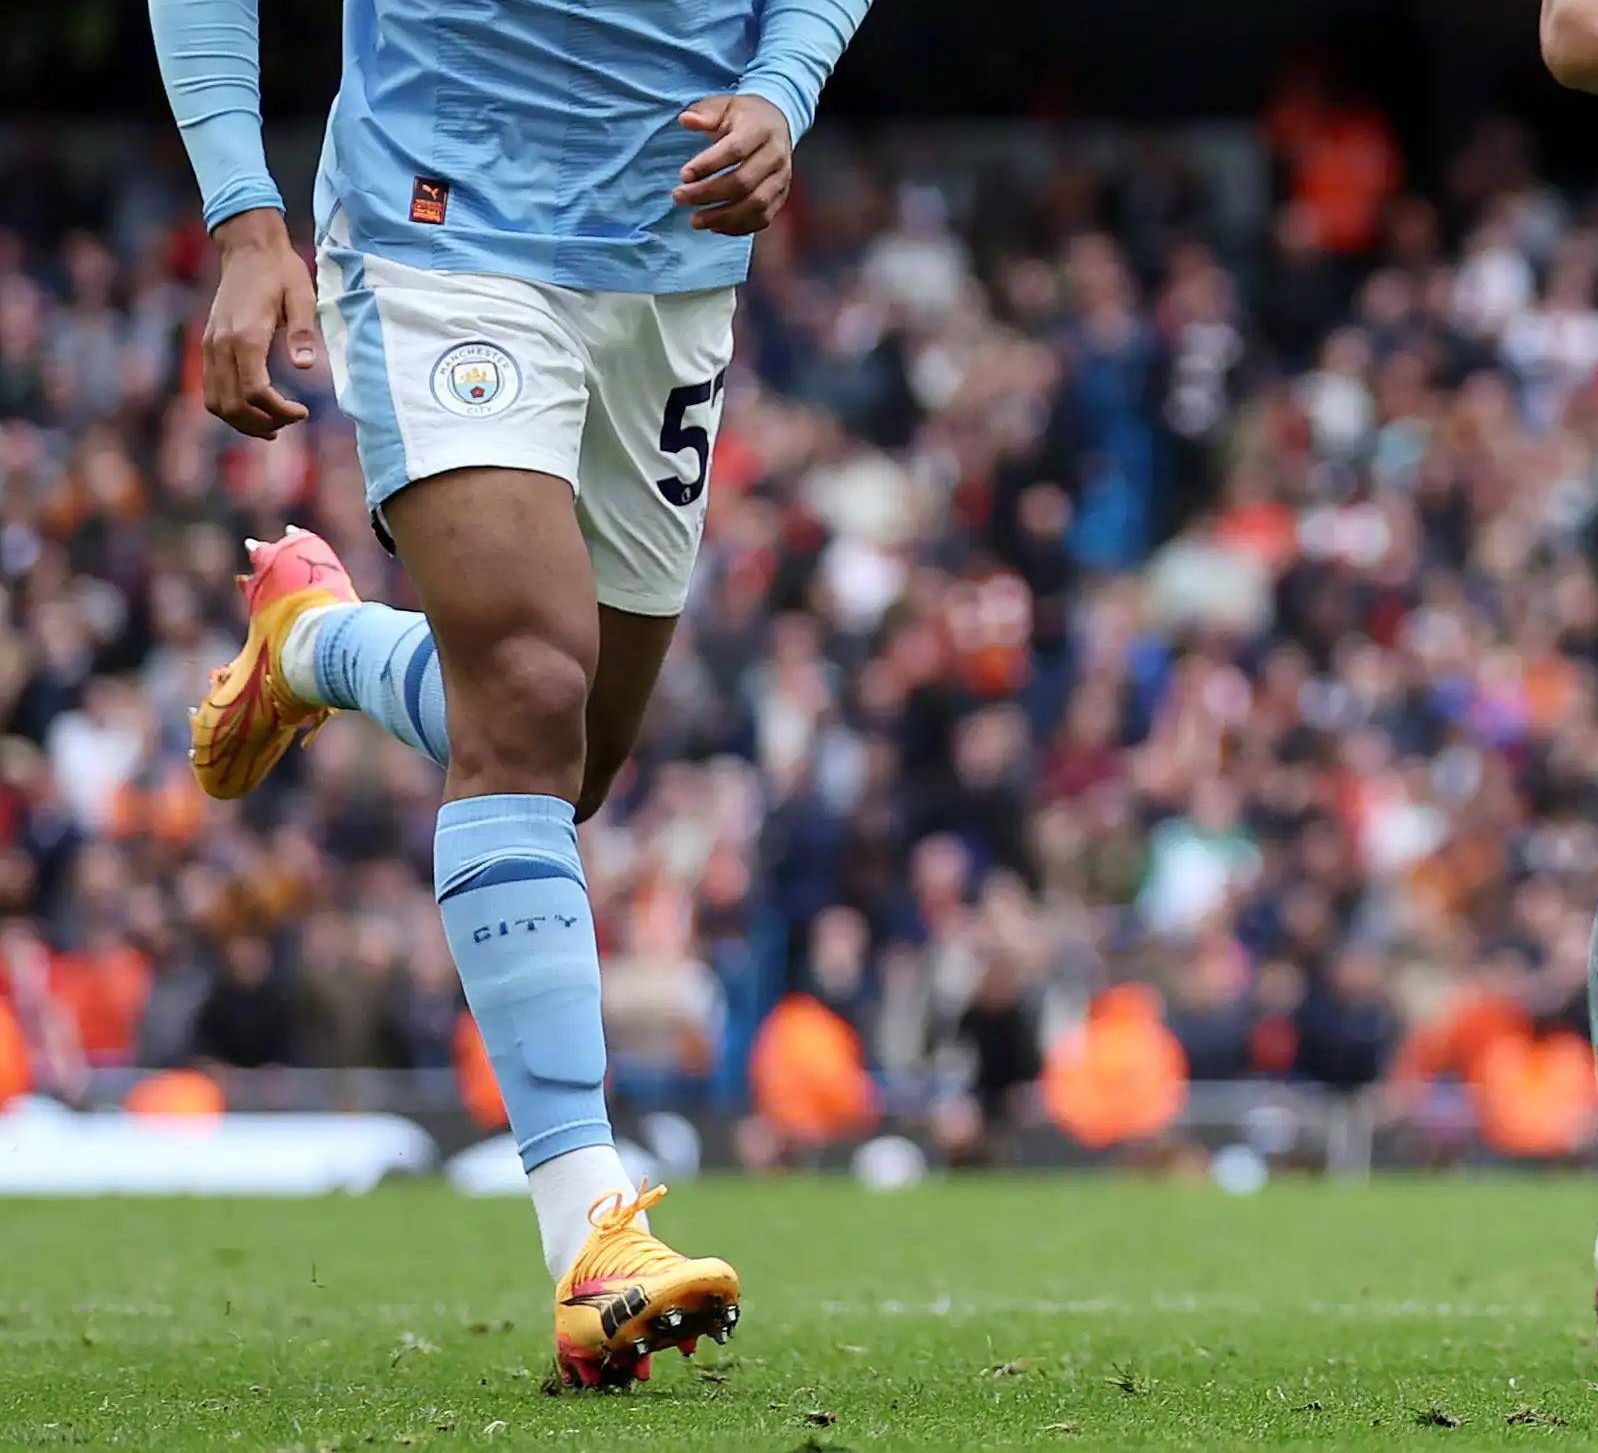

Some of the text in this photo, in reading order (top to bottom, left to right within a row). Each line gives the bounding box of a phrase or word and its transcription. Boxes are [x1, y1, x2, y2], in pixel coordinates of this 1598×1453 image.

[440, 347, 511, 376] MANCHESTER
[466, 405, 493, 416] CITY
[471, 913, 578, 945] CITY
